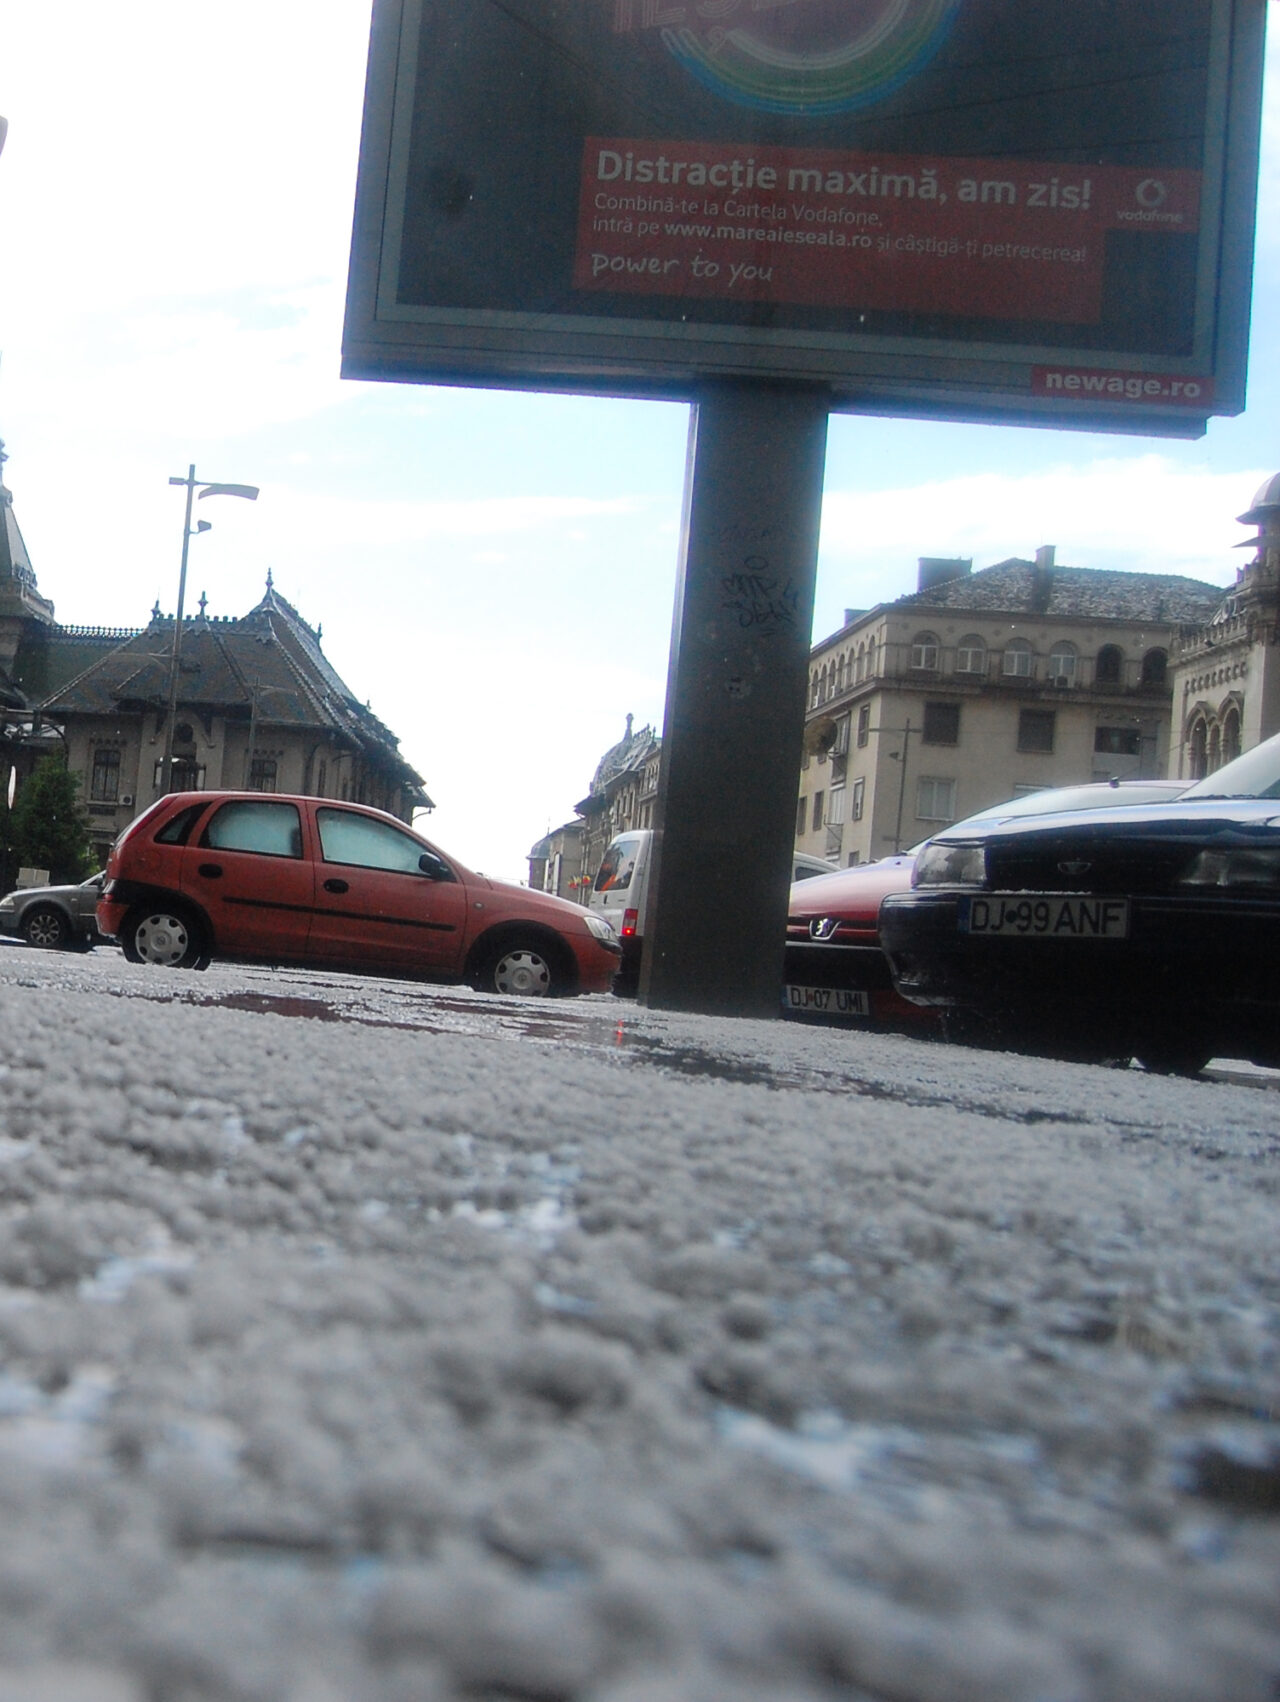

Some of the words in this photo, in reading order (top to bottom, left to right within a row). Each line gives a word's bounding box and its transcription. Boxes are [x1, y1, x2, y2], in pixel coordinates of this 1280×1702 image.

[594, 192, 700, 214] Combină-te
[703, 200, 720, 216] la
[723, 200, 787, 220] Cartela
[787, 165, 948, 205] maximă,
[957, 178, 1017, 205] am
[1026, 177, 1092, 211] zis!
[592, 215, 633, 234] intră
[637, 222, 660, 239] pe
[664, 222, 873, 249] www.mareaieseala.ro
[981, 239, 1087, 264] petrecerea!
[591, 252, 680, 277] power
[690, 252, 720, 277] to
[729, 258, 774, 288] you
[1045, 371, 1202, 399] newage.ro
